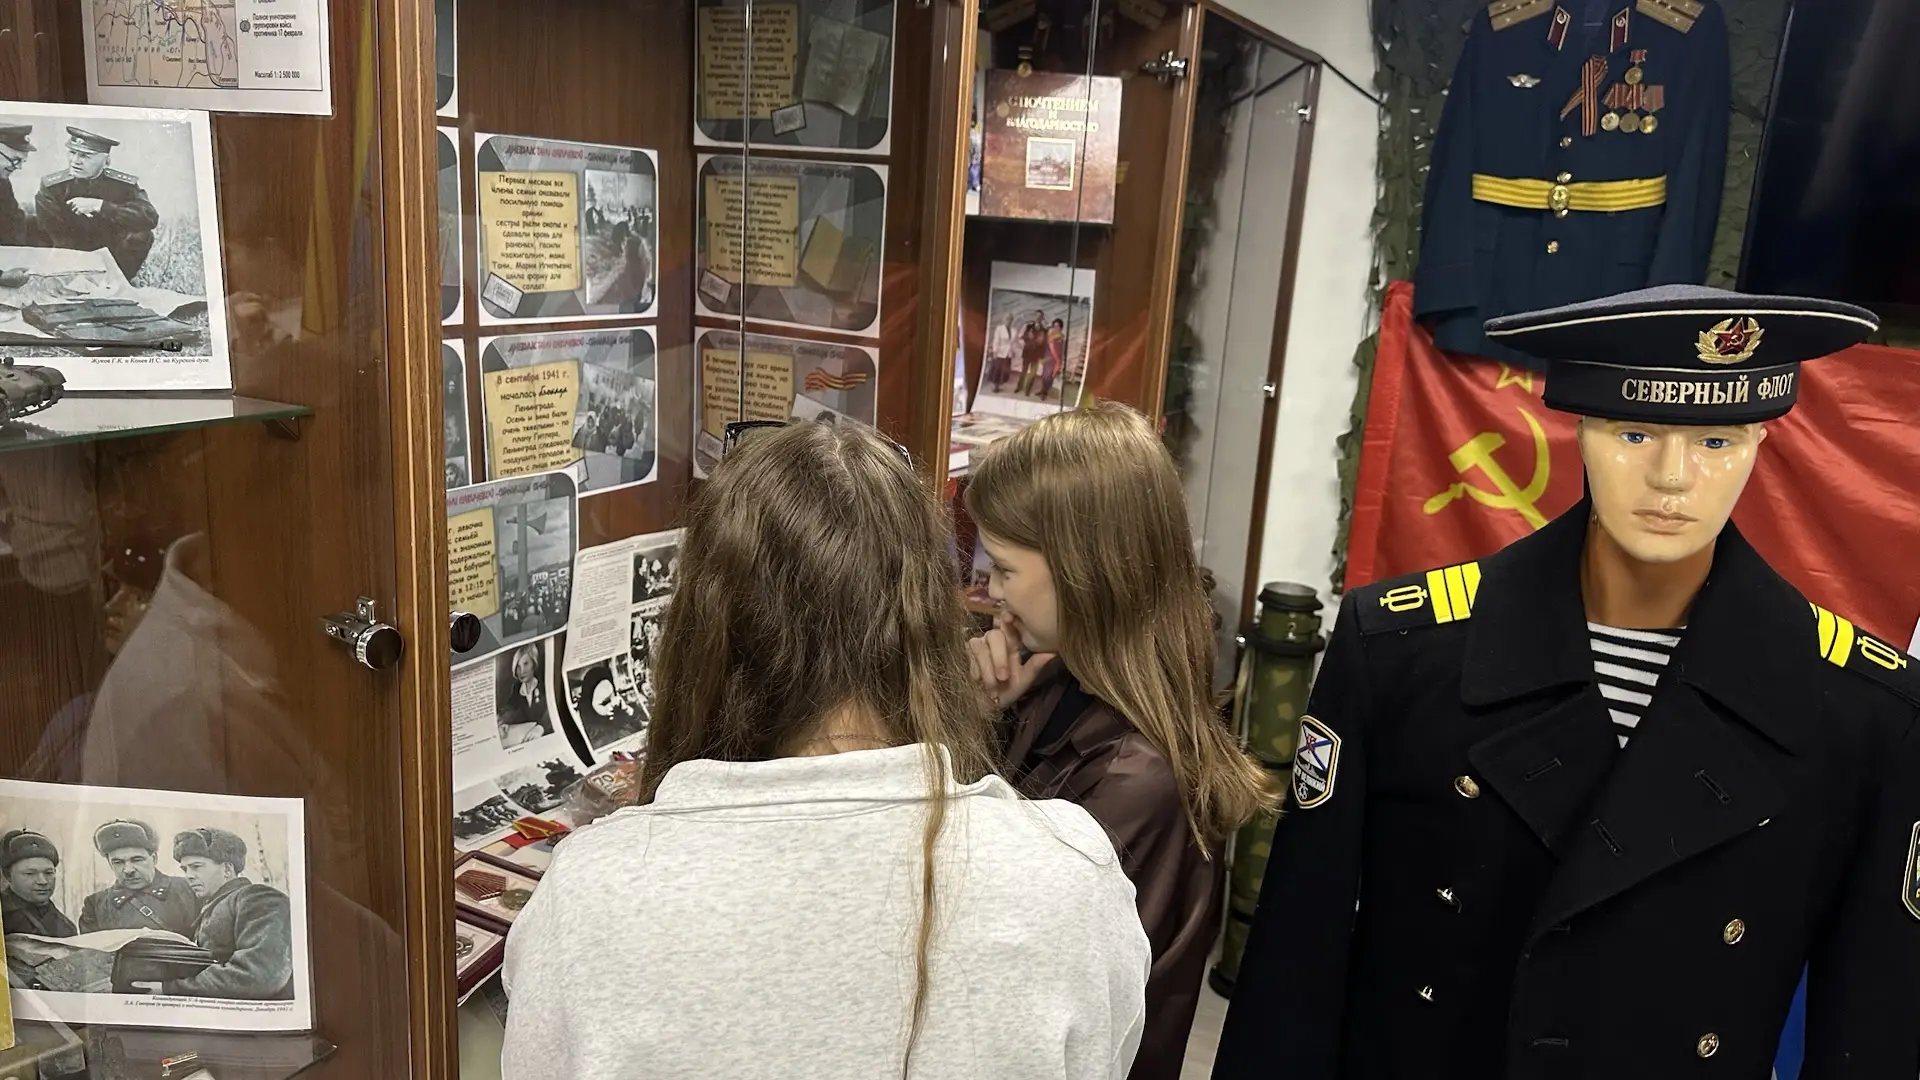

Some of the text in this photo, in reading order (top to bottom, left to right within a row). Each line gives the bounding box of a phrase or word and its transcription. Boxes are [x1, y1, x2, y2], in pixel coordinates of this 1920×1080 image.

[499, 174, 526, 186] Первые
[500, 199, 538, 208] посильную
[505, 373, 540, 384] сентября
[542, 370, 560, 380] 1941
[1621, 372, 1794, 404] СЕВЕРНЫЙ ФЛОТ
[500, 392, 537, 400] началась
[506, 416, 525, 424] Осень
[502, 444, 537, 455] Ленинград
[465, 580, 484, 592] 12:15
